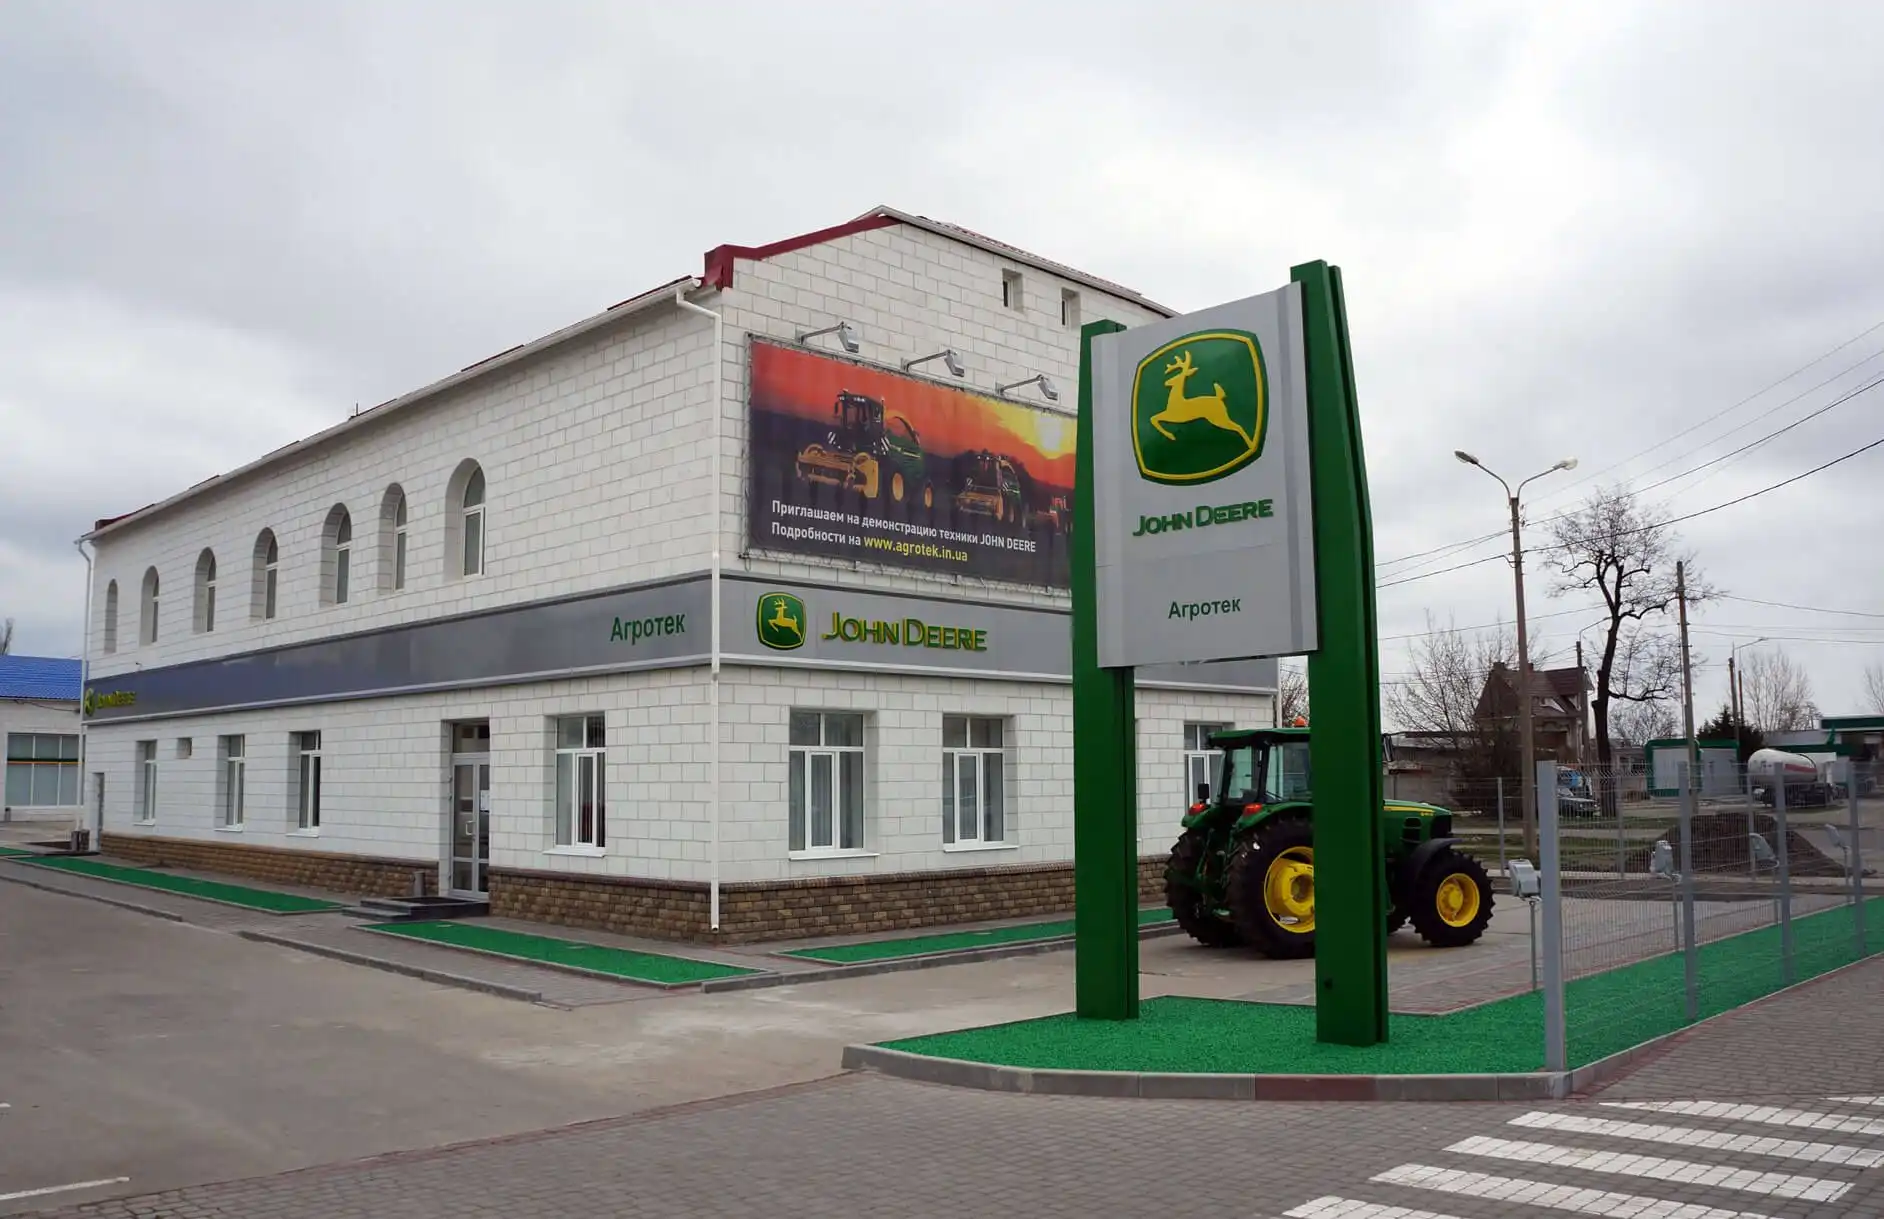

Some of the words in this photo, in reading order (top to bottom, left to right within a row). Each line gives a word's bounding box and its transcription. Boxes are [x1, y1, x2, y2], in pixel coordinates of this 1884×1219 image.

[772, 500, 844, 523] Приглашаем
[847, 513, 860, 525] на
[862, 516, 937, 537] демонстрацию
[939, 528, 978, 544] техники
[980, 534, 1004, 549] JOHN
[1006, 538, 1036, 553] DEERE
[1132, 511, 1193, 537] JOHN
[1195, 498, 1274, 527] DEERE
[771, 522, 846, 543] Подробности
[848, 534, 861, 546] на
[864, 536, 968, 561] www.agrotek.in.ua
[1168, 598, 1241, 621] Агротек
[610, 613, 686, 646] Агротек
[821, 611, 900, 645] JOHN
[903, 618, 988, 651] DEERE
